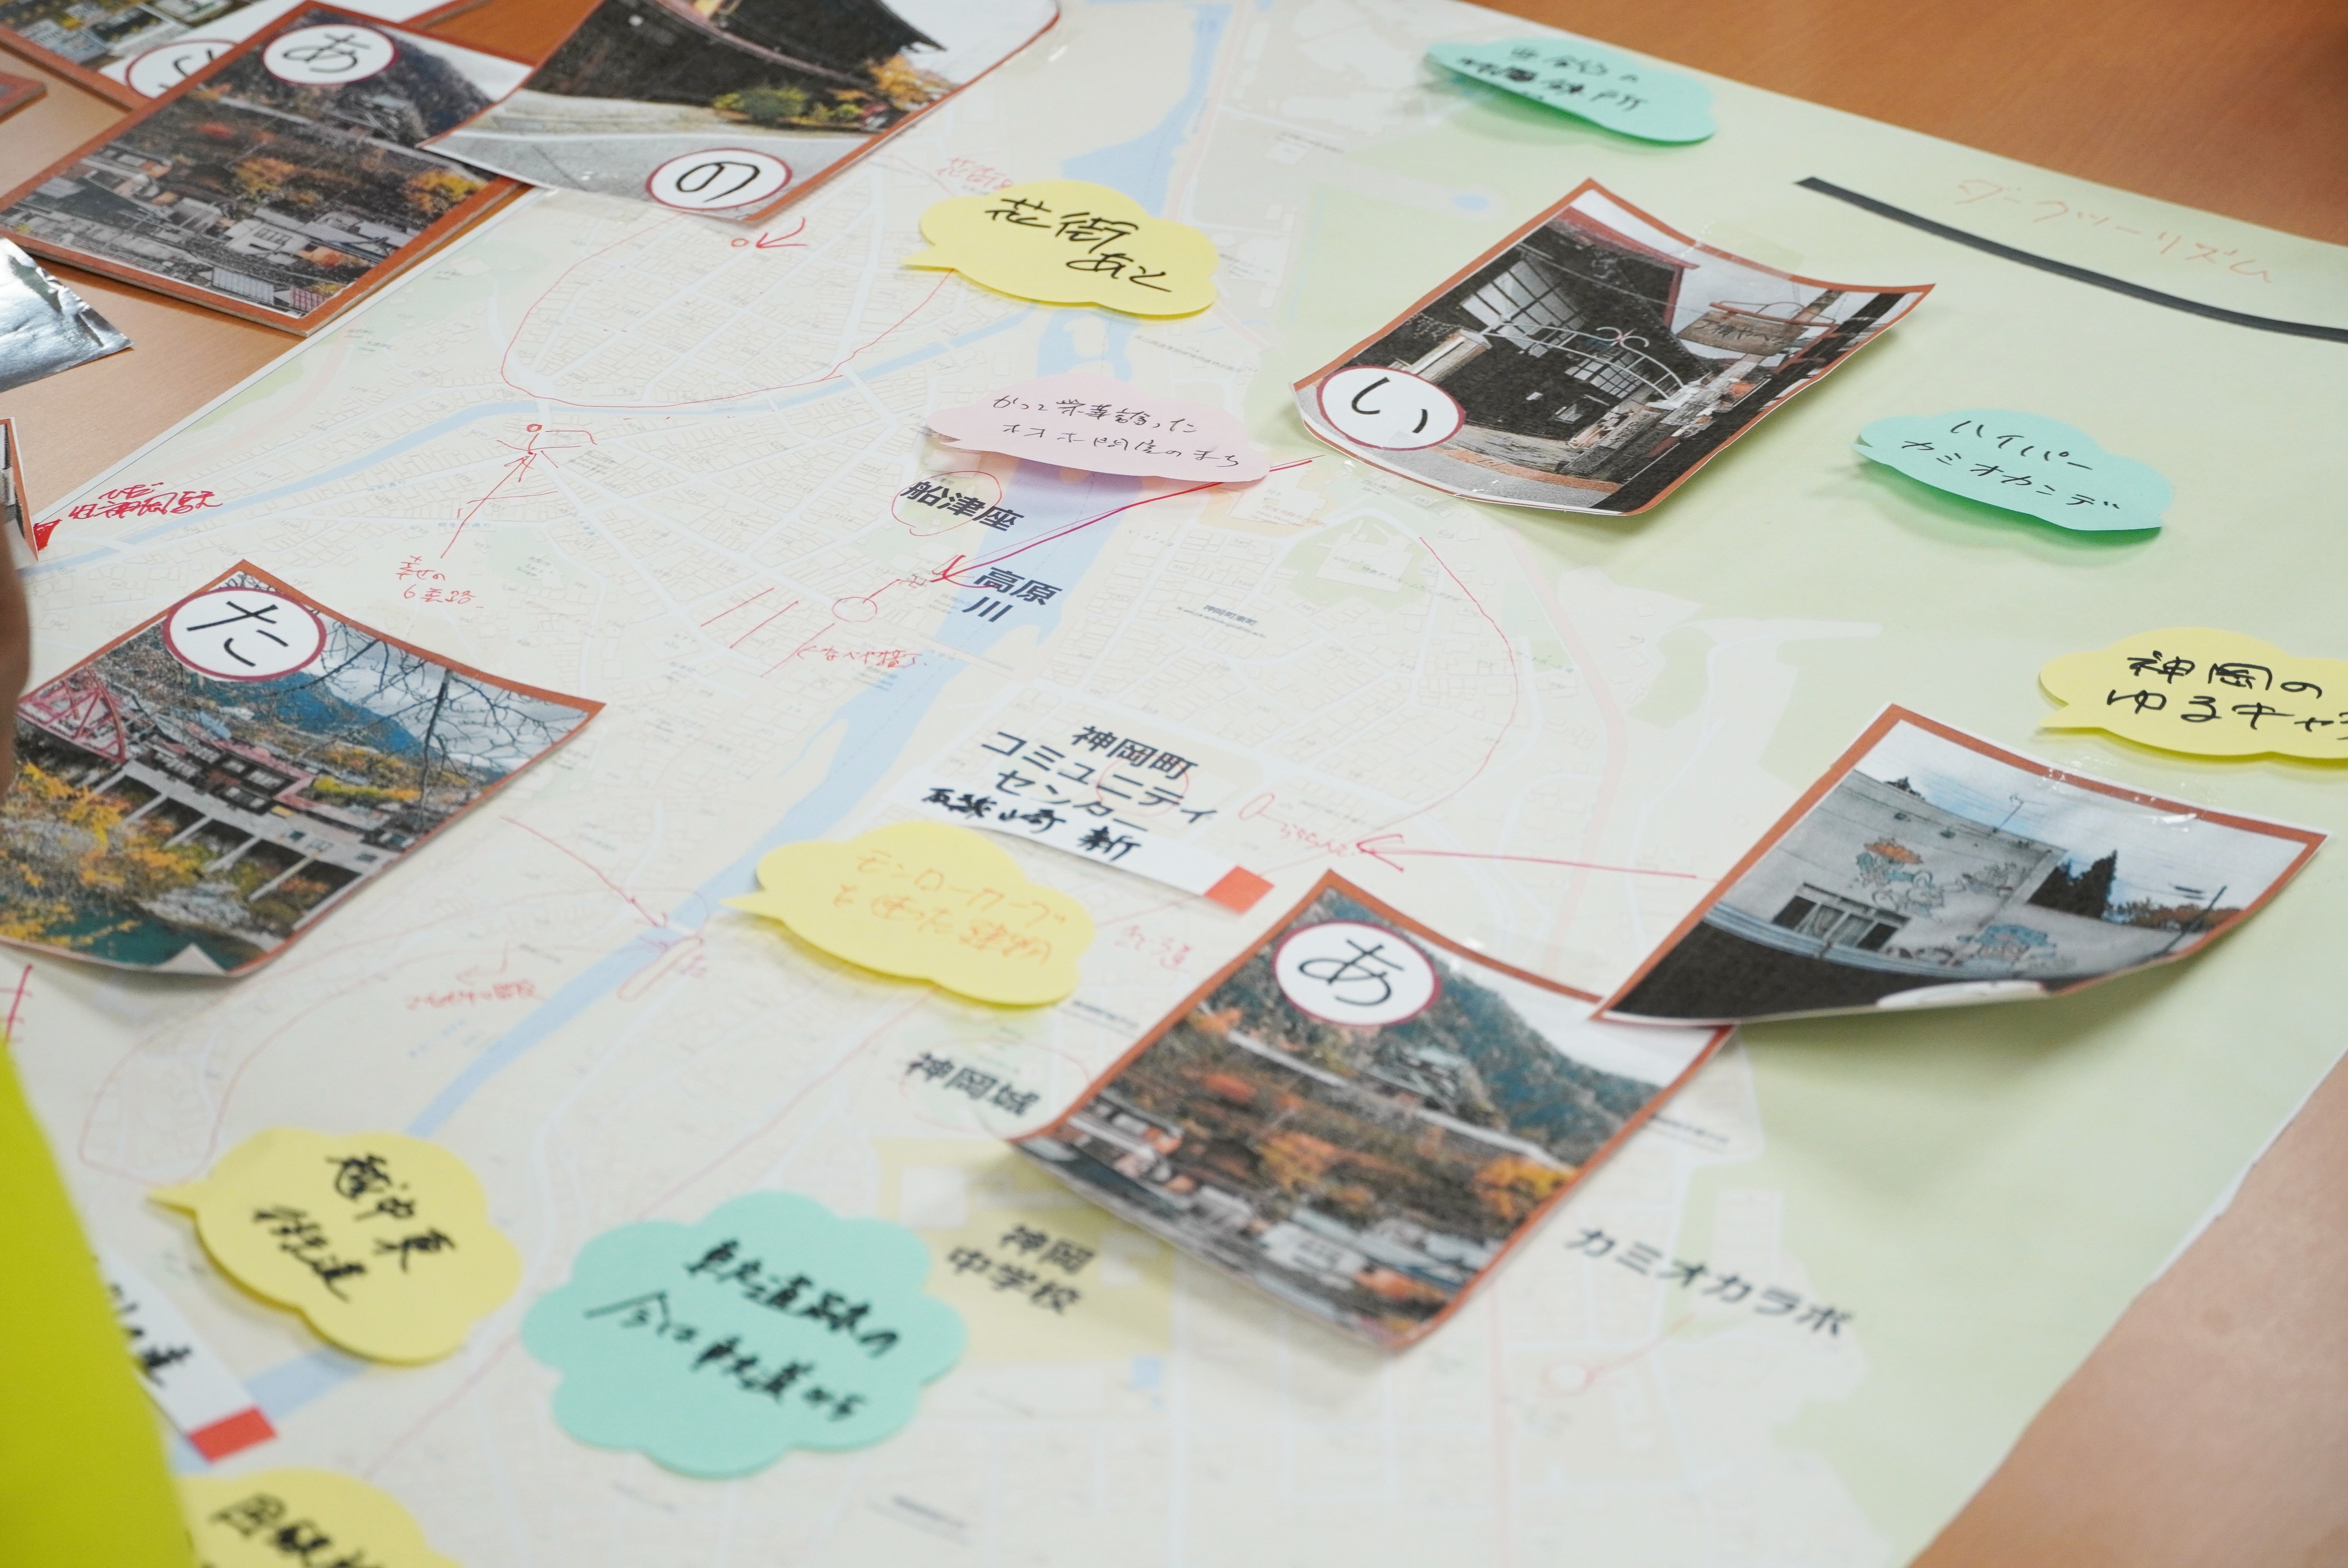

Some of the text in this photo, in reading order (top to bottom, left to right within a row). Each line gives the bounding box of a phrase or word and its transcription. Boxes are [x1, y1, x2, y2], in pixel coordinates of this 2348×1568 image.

[283, 33, 372, 73] あ
[675, 161, 761, 203] の
[984, 197, 1140, 255] 花街
[1065, 252, 1173, 293] あと
[1350, 376, 1430, 435] い
[1949, 419, 2094, 471] ハイパー
[97, 482, 165, 500] ひだ
[1901, 440, 2122, 510] カミオカンデ
[899, 481, 1026, 533] 船津座
[961, 595, 1015, 624] 川
[972, 566, 1064, 606] 高原
[186, 600, 290, 668] た
[2126, 649, 2324, 700] 神岡の
[980, 730, 1219, 826] コミュニティ
[1069, 724, 1199, 782] 神岡町
[996, 769, 1150, 833] センター
[1297, 937, 1405, 1008] あ
[904, 1051, 1042, 1119] 神岡城
[945, 1242, 1083, 1317] 中学校
[999, 1223, 1095, 1278] 神岡
[1564, 1226, 1856, 1339] カミオカラボ
